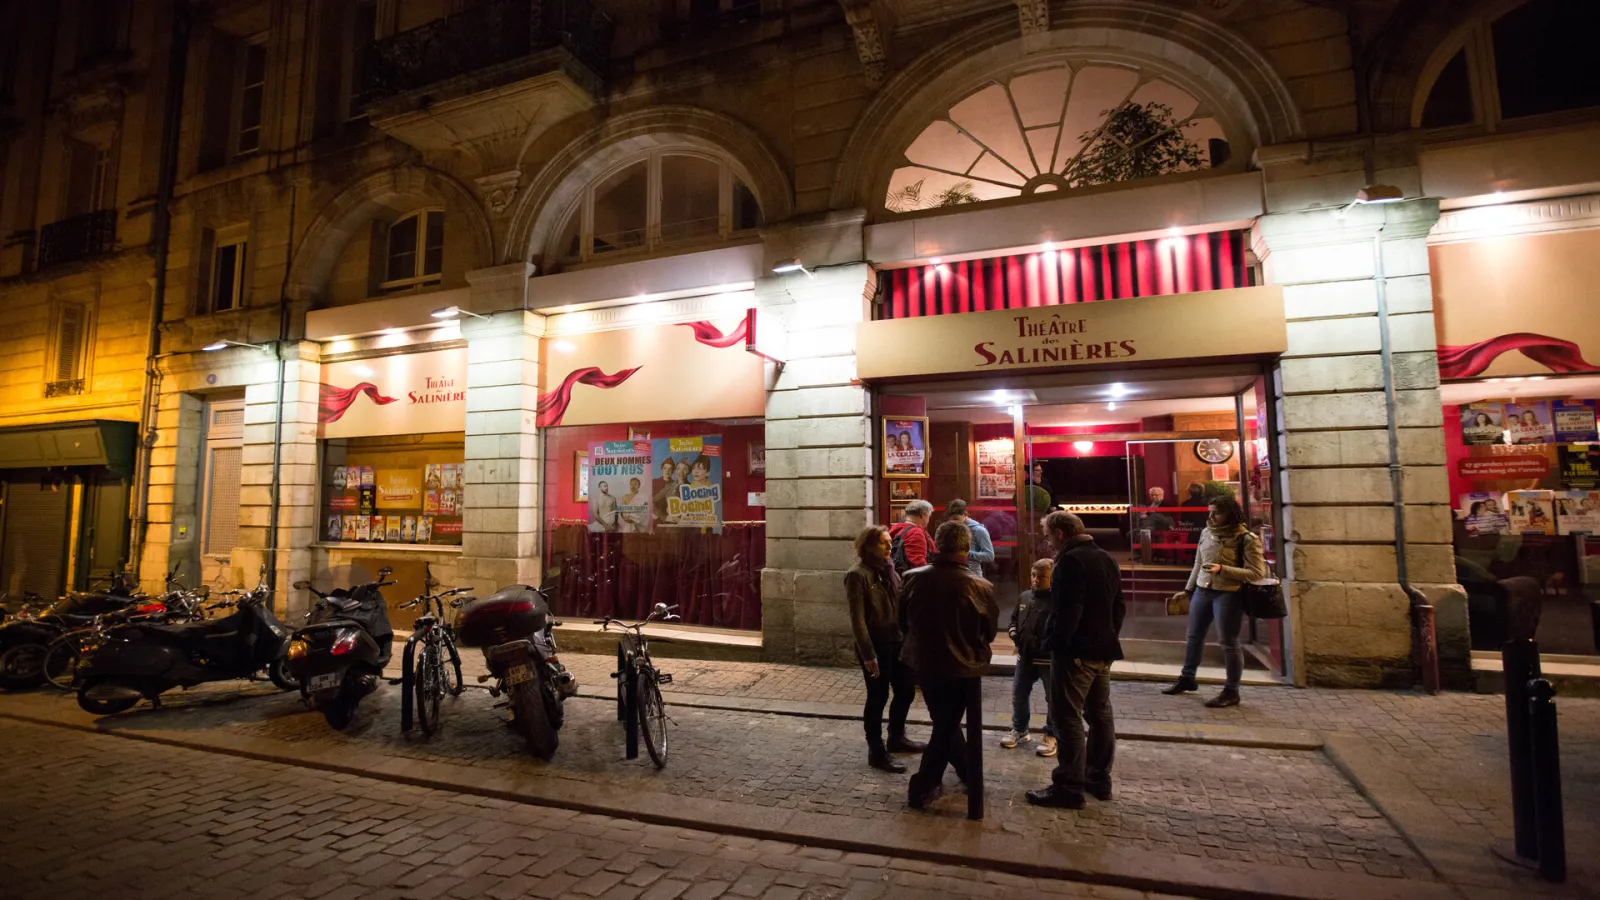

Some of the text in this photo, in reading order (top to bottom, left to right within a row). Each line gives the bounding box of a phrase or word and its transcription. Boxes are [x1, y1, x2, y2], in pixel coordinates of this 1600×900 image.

[1014, 313, 1087, 338] THÉÂTRE
[974, 339, 1137, 366] SALINIÈRES
[408, 390, 466, 405] SALINIÈRE
[595, 456, 652, 465] DEUX HOMMES
[592, 464, 644, 475] TOUT NUS
[681, 485, 720, 501] Boeing
[669, 498, 714, 515] Boeing
